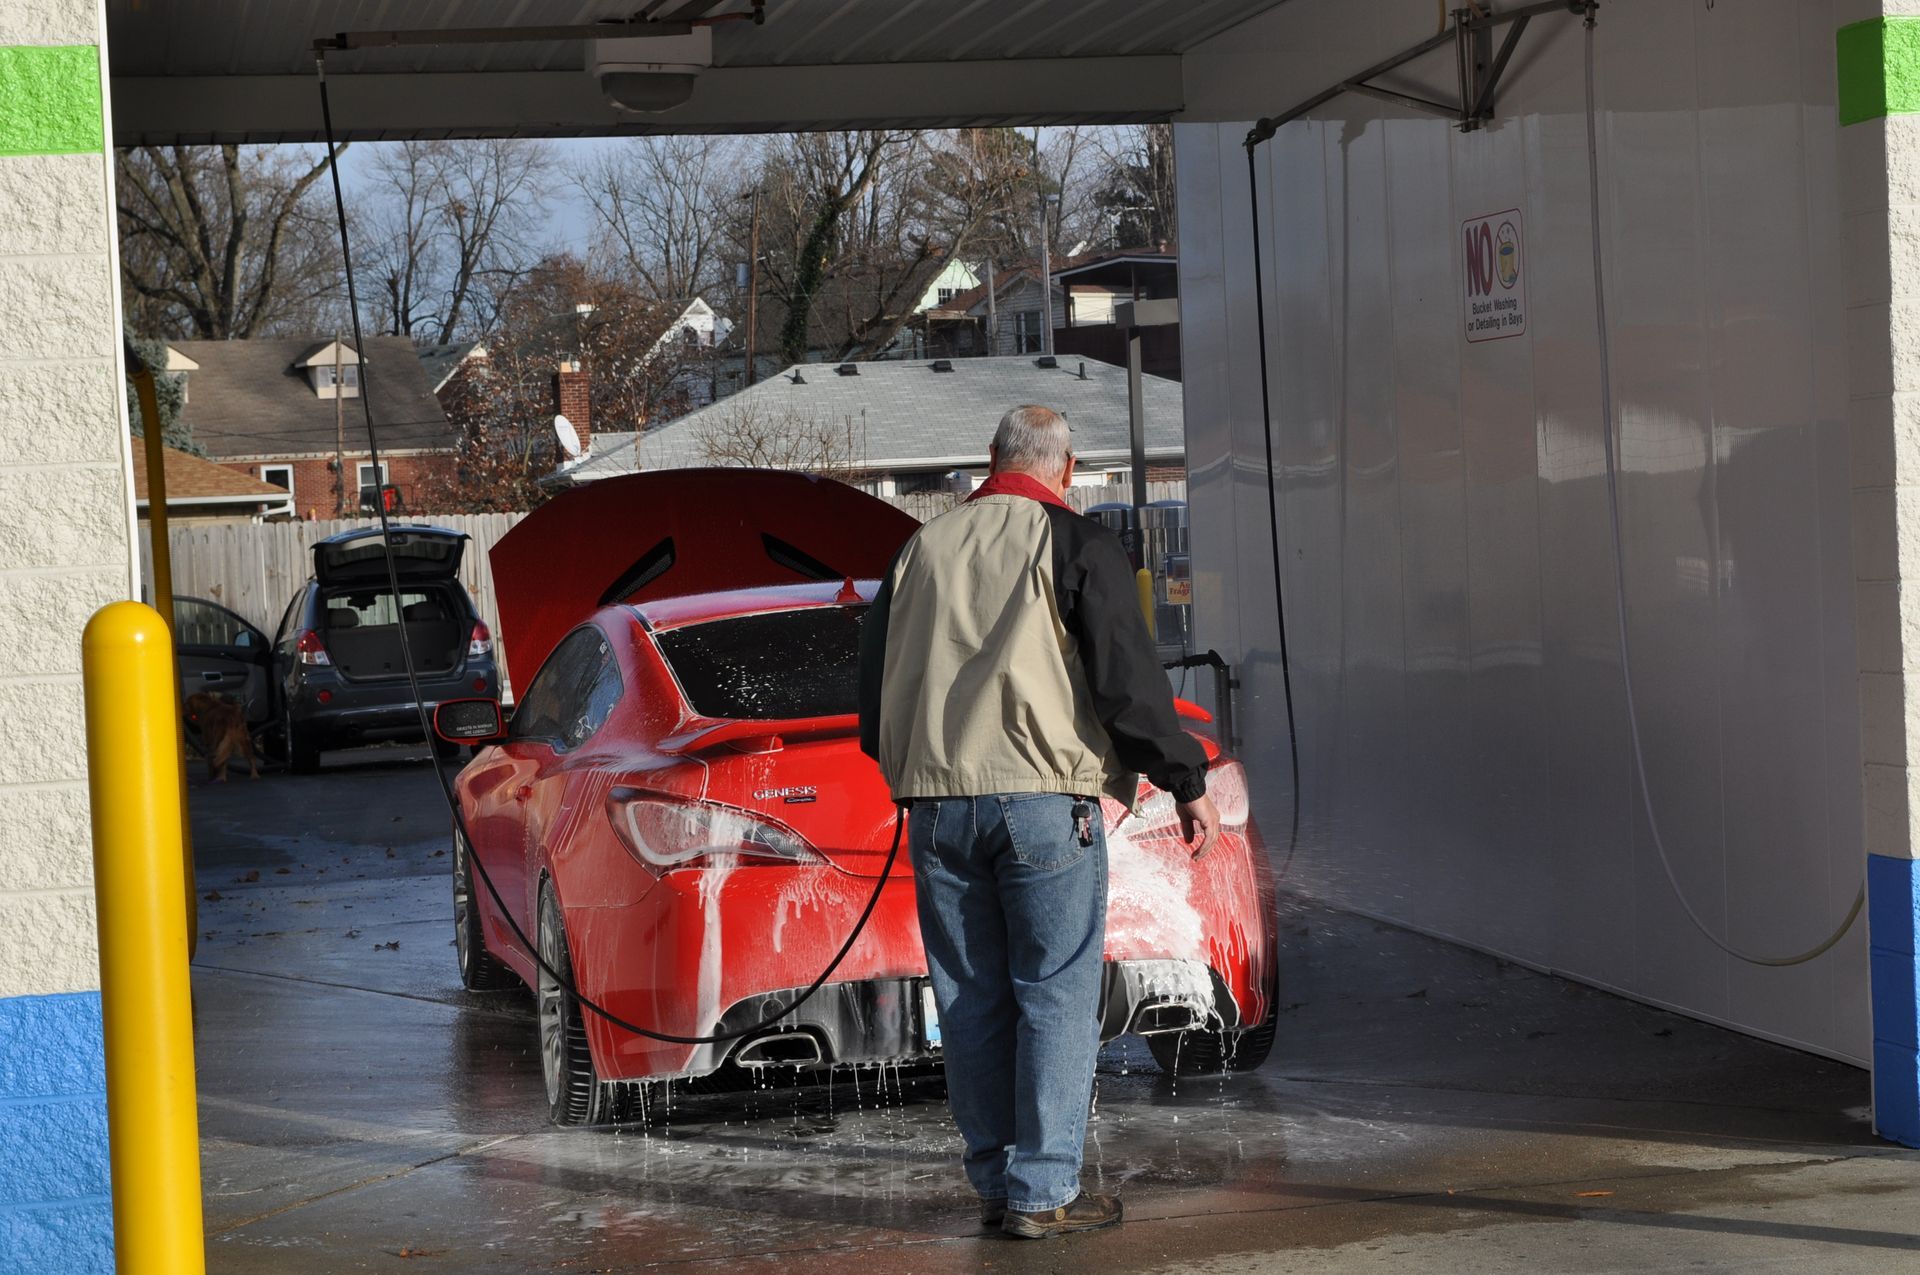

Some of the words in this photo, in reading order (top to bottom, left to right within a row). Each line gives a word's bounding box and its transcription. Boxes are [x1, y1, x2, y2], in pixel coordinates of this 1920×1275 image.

[1466, 222, 1493, 297] NO
[1472, 300, 1492, 315] Bucket
[1494, 297, 1517, 312] Washing
[1468, 322, 1474, 331] or
[1476, 317, 1500, 330] Detailing
[1502, 314, 1508, 326] in
[1509, 313, 1523, 327] Bays
[754, 786, 817, 801] GENESIS
